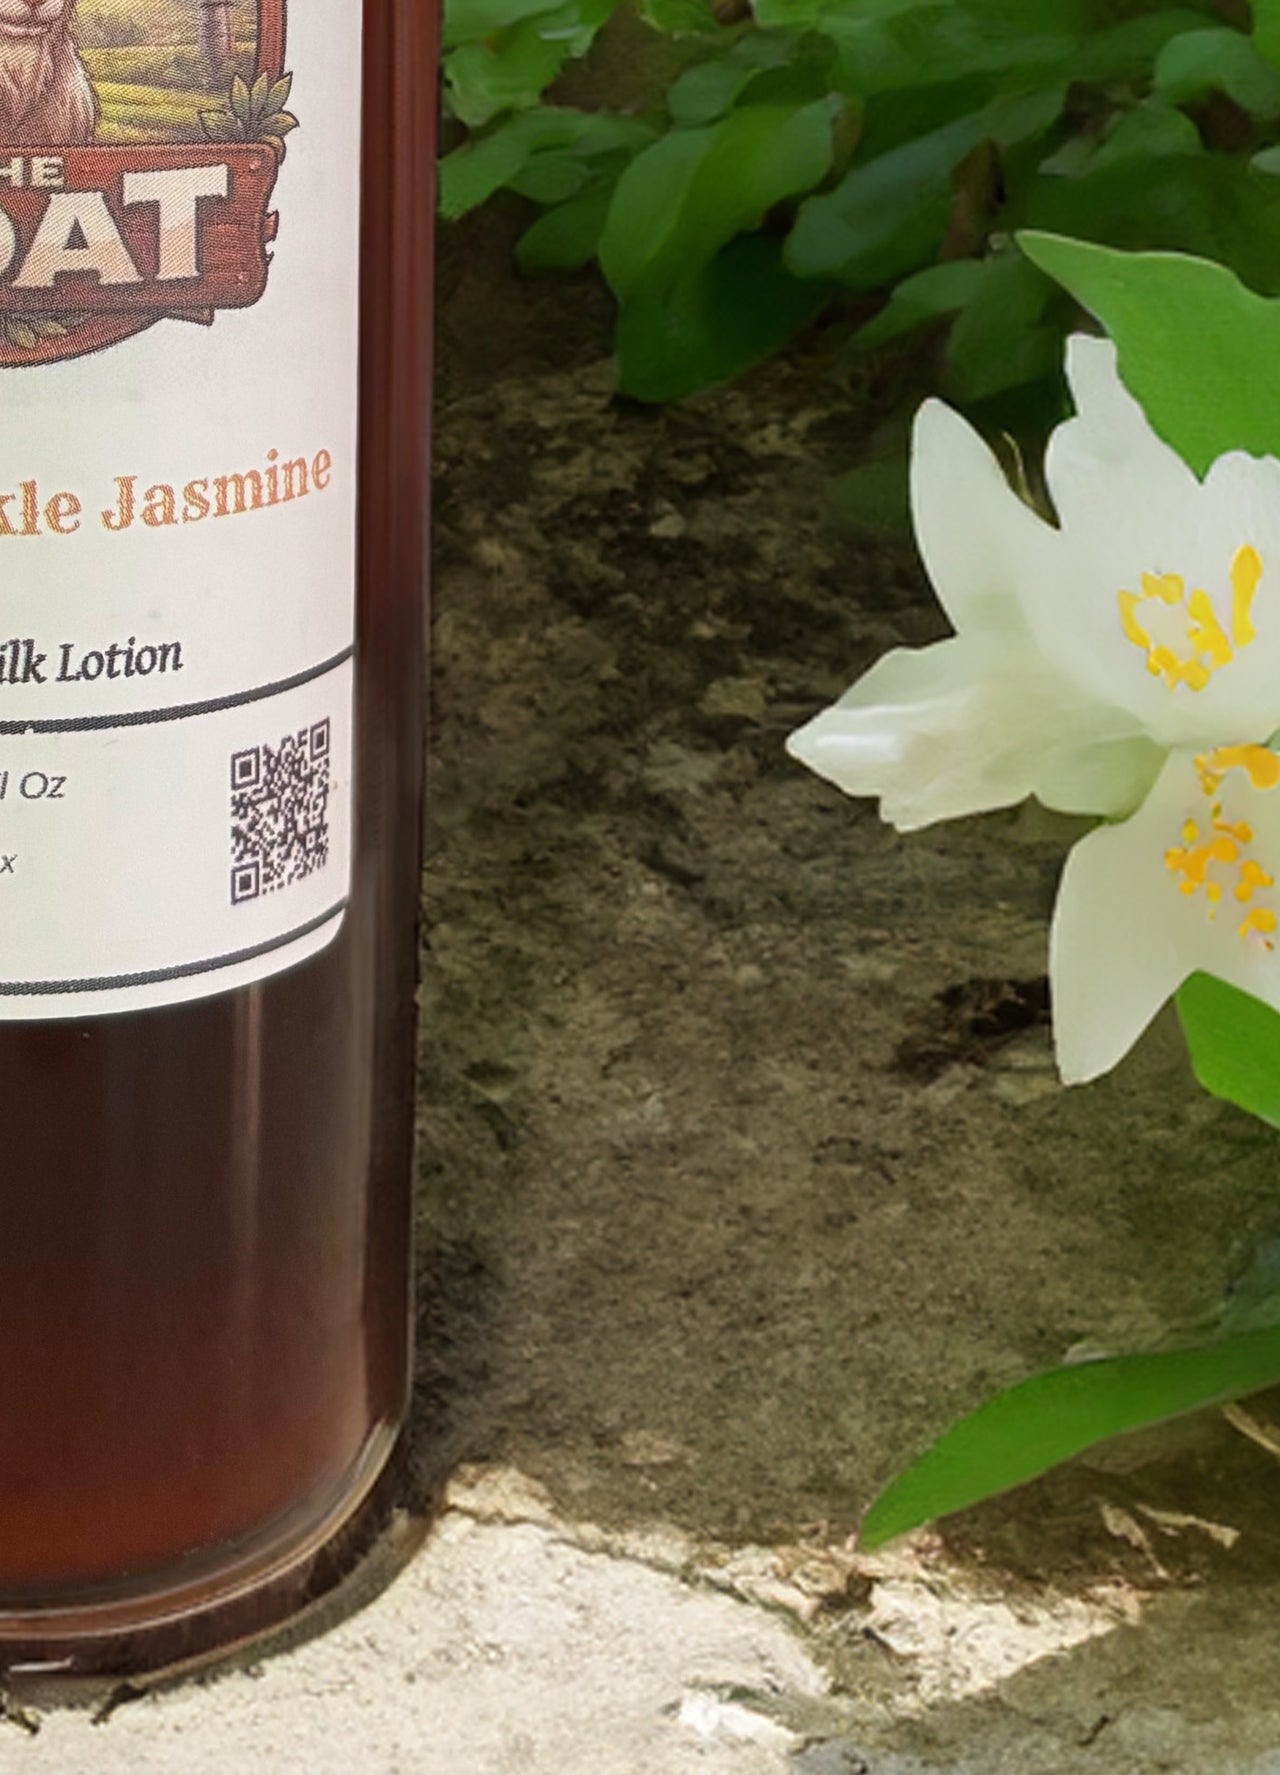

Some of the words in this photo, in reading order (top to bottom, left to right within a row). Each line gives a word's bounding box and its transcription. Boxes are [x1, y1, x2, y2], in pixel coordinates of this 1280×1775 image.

[101, 447, 333, 532] Jasmine
[55, 636, 184, 683] Lotion
[20, 771, 67, 800] Oz
